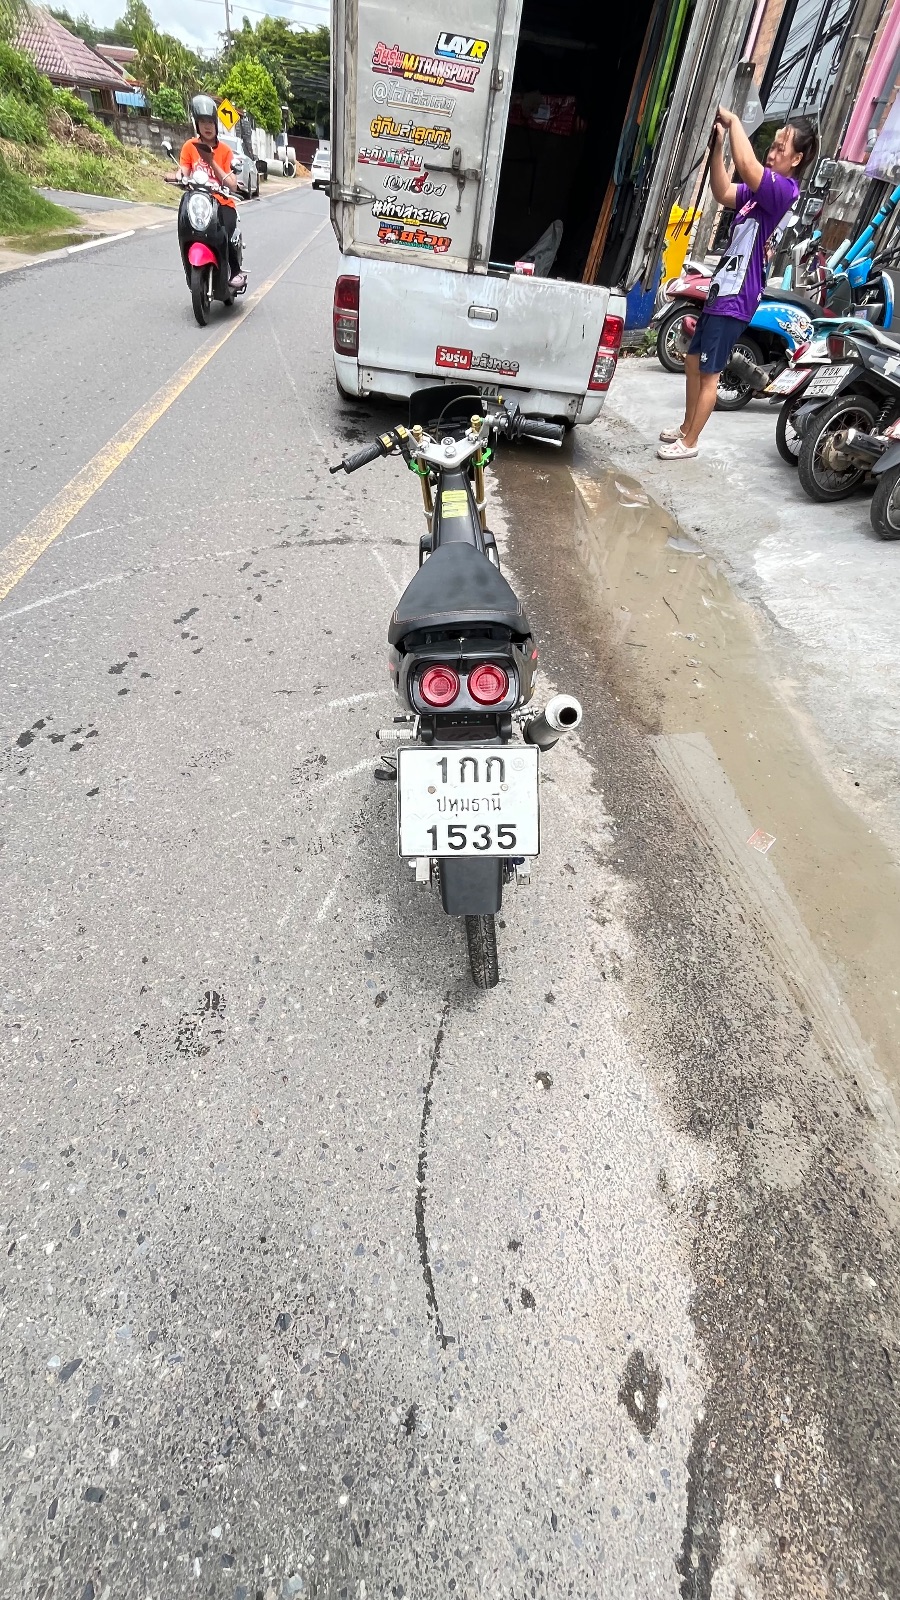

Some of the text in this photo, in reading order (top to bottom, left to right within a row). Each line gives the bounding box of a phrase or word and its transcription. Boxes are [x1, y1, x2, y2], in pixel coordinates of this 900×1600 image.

[438, 33, 488, 58] LAYR
[436, 756, 505, 783] 1กก
[436, 793, 501, 817] ปทุมธานี
[427, 824, 517, 850] 1535
